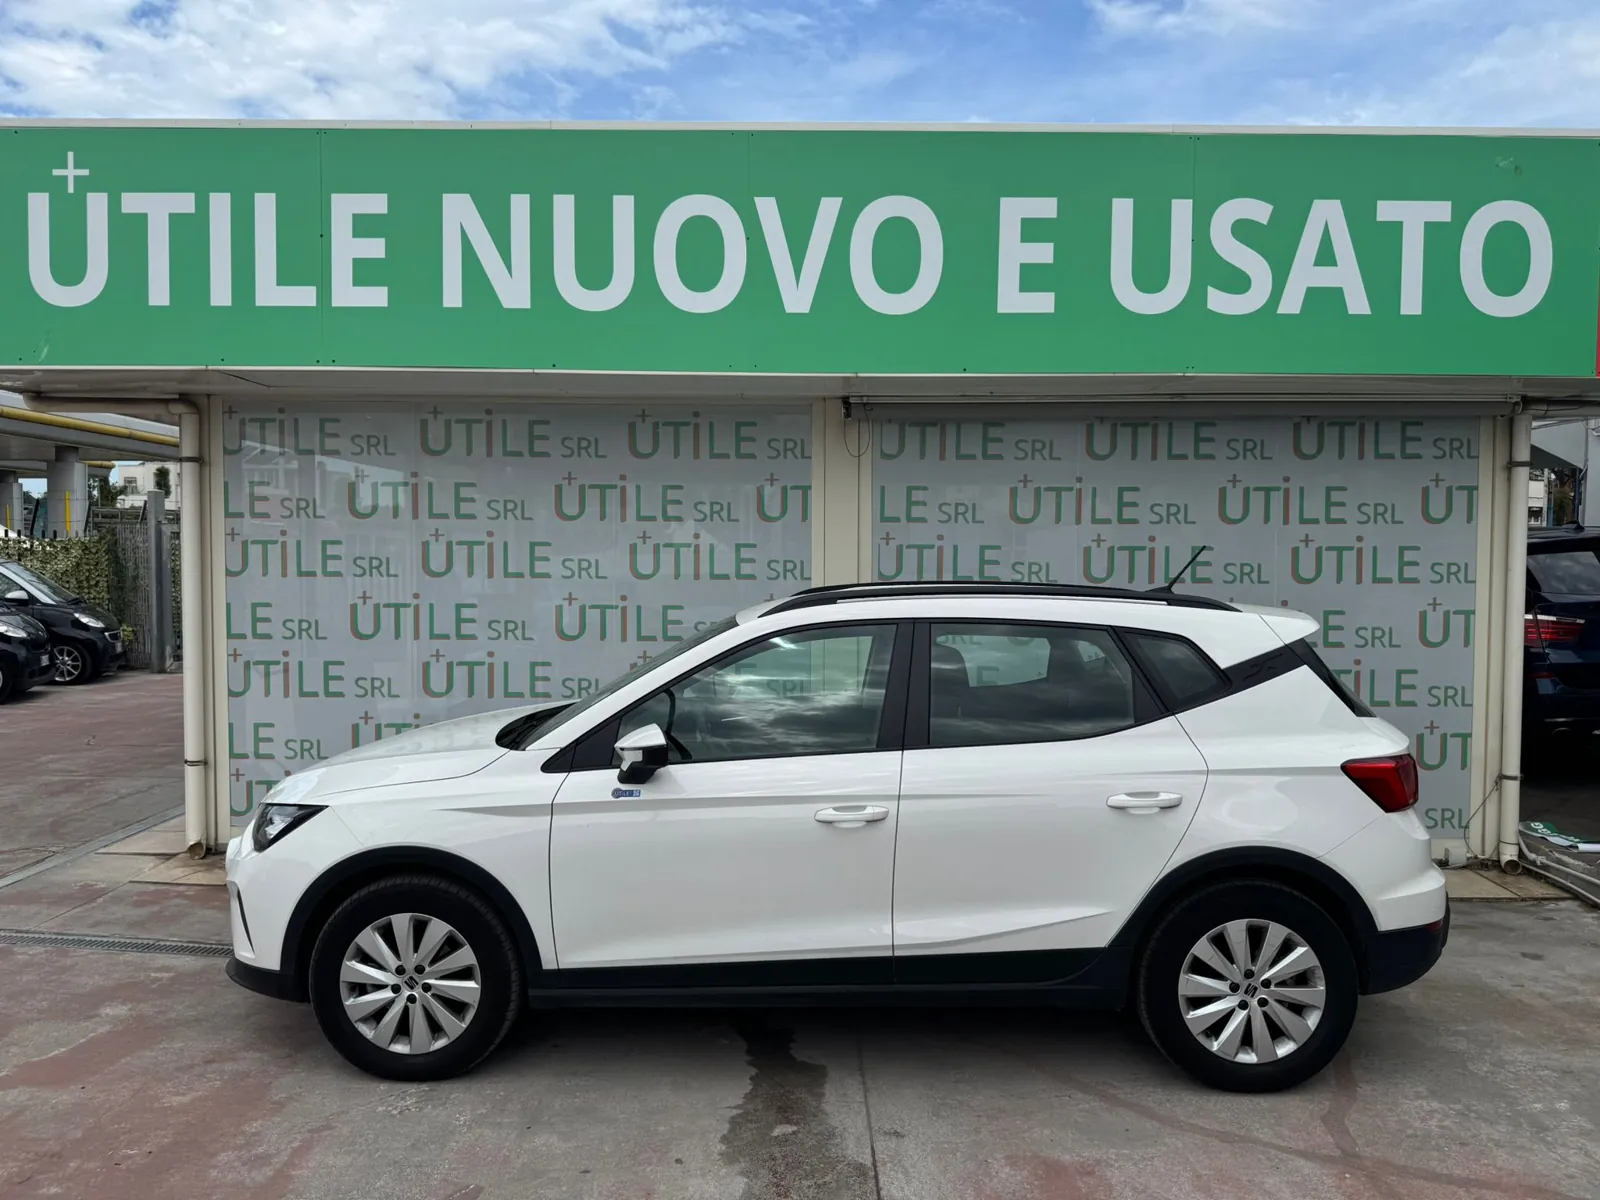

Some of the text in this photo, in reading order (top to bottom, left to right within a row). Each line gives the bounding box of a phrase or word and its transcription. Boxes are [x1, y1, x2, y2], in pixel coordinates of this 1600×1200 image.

[442, 193, 944, 315] NUOVO
[997, 197, 1058, 313] E
[1110, 198, 1553, 317] USATO
[350, 434, 396, 456] SRL
[560, 437, 607, 459] SRL
[767, 438, 811, 460] SRL
[1014, 439, 1062, 461] SRL
[1226, 438, 1273, 460] SRL
[1432, 437, 1479, 460] SRL
[224, 481, 326, 520] LE SRL
[487, 499, 534, 521] SRL
[880, 485, 985, 524] LE SRL
[693, 501, 740, 523] SRL
[1149, 503, 1197, 525] SRL
[1356, 503, 1404, 525] SRL
[352, 556, 399, 579] SRL
[561, 557, 608, 580] SRL
[766, 559, 812, 581] SRL
[1010, 562, 1058, 583] SRL
[1222, 563, 1270, 584] SRL
[1429, 562, 1476, 584] SRL
[227, 602, 328, 641] LE SRL
[487, 619, 535, 641] SRL
[1354, 626, 1401, 648] SRL
[354, 676, 401, 698] SRL
[1427, 686, 1473, 707] SRL
[229, 722, 329, 761] LE SRL
[1425, 807, 1469, 830] SRL
